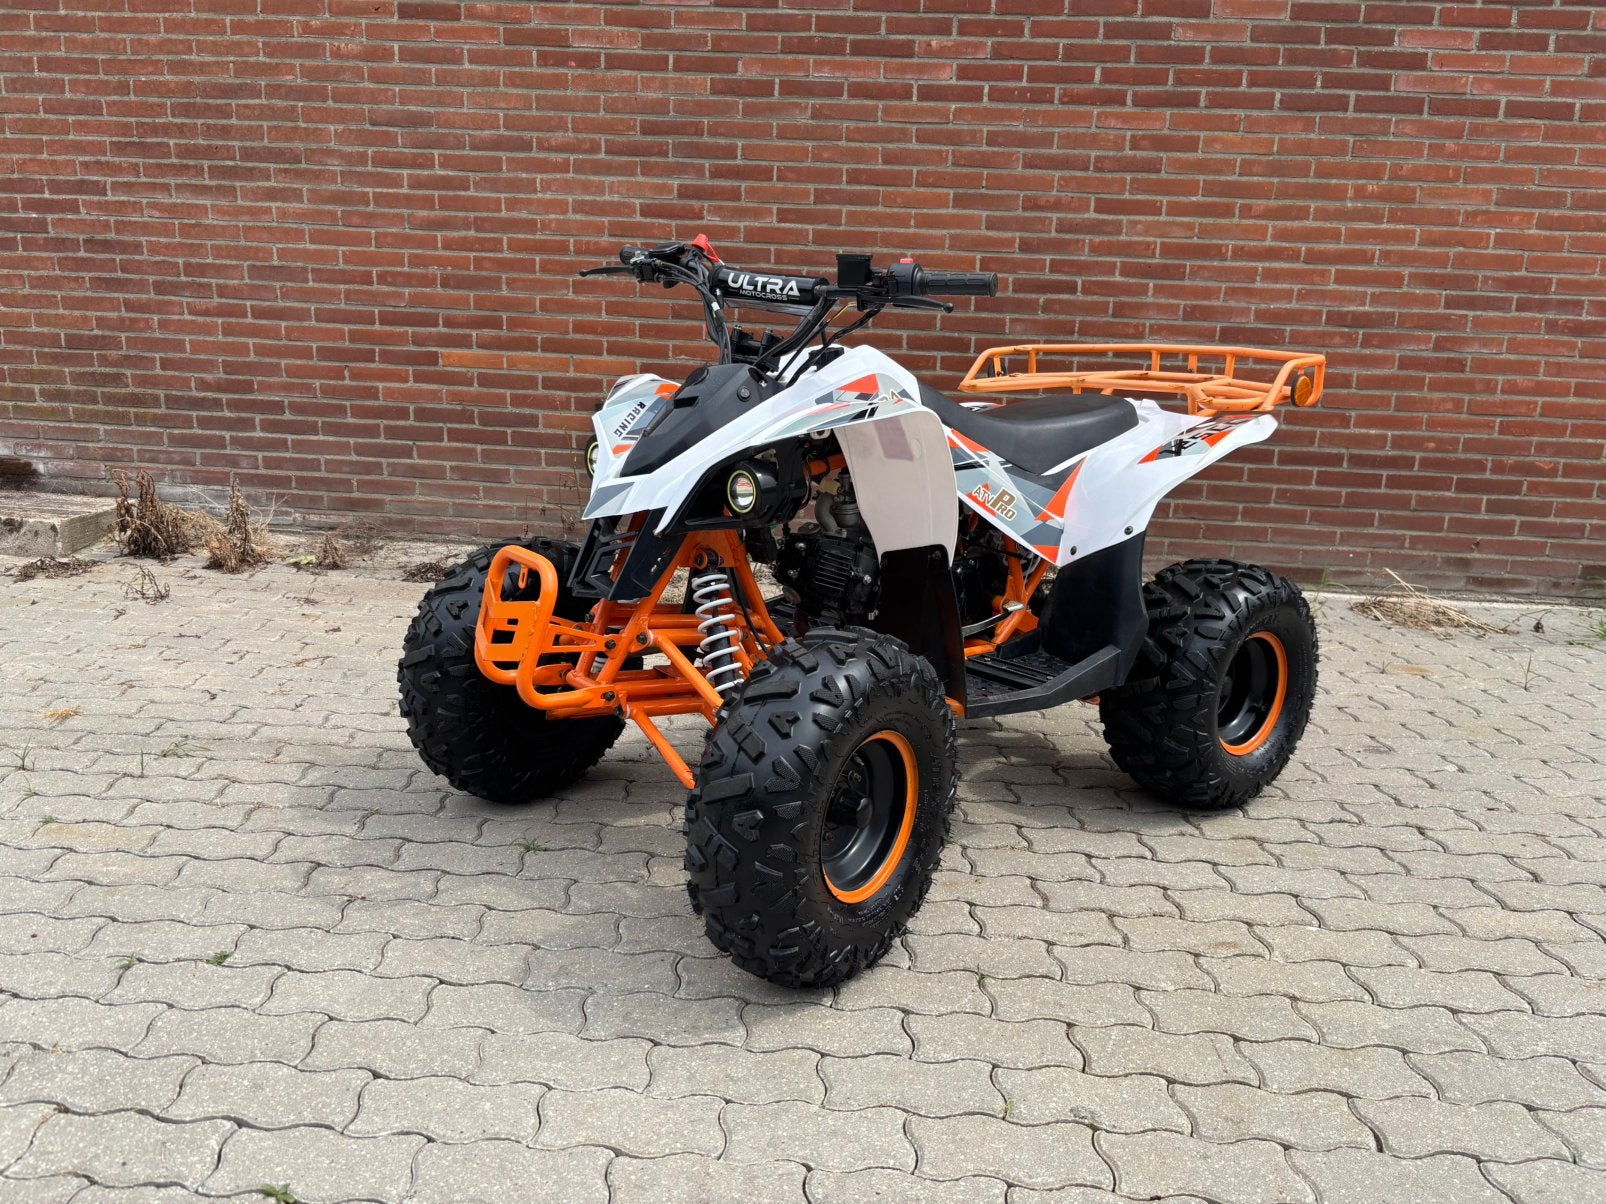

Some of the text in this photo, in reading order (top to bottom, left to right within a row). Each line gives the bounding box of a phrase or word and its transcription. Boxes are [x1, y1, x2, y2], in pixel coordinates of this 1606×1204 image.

[728, 272, 800, 296] ULTRA
[740, 289, 788, 301] MOTOCROSS
[613, 401, 647, 438] RACING
[973, 486, 994, 505] ATV
